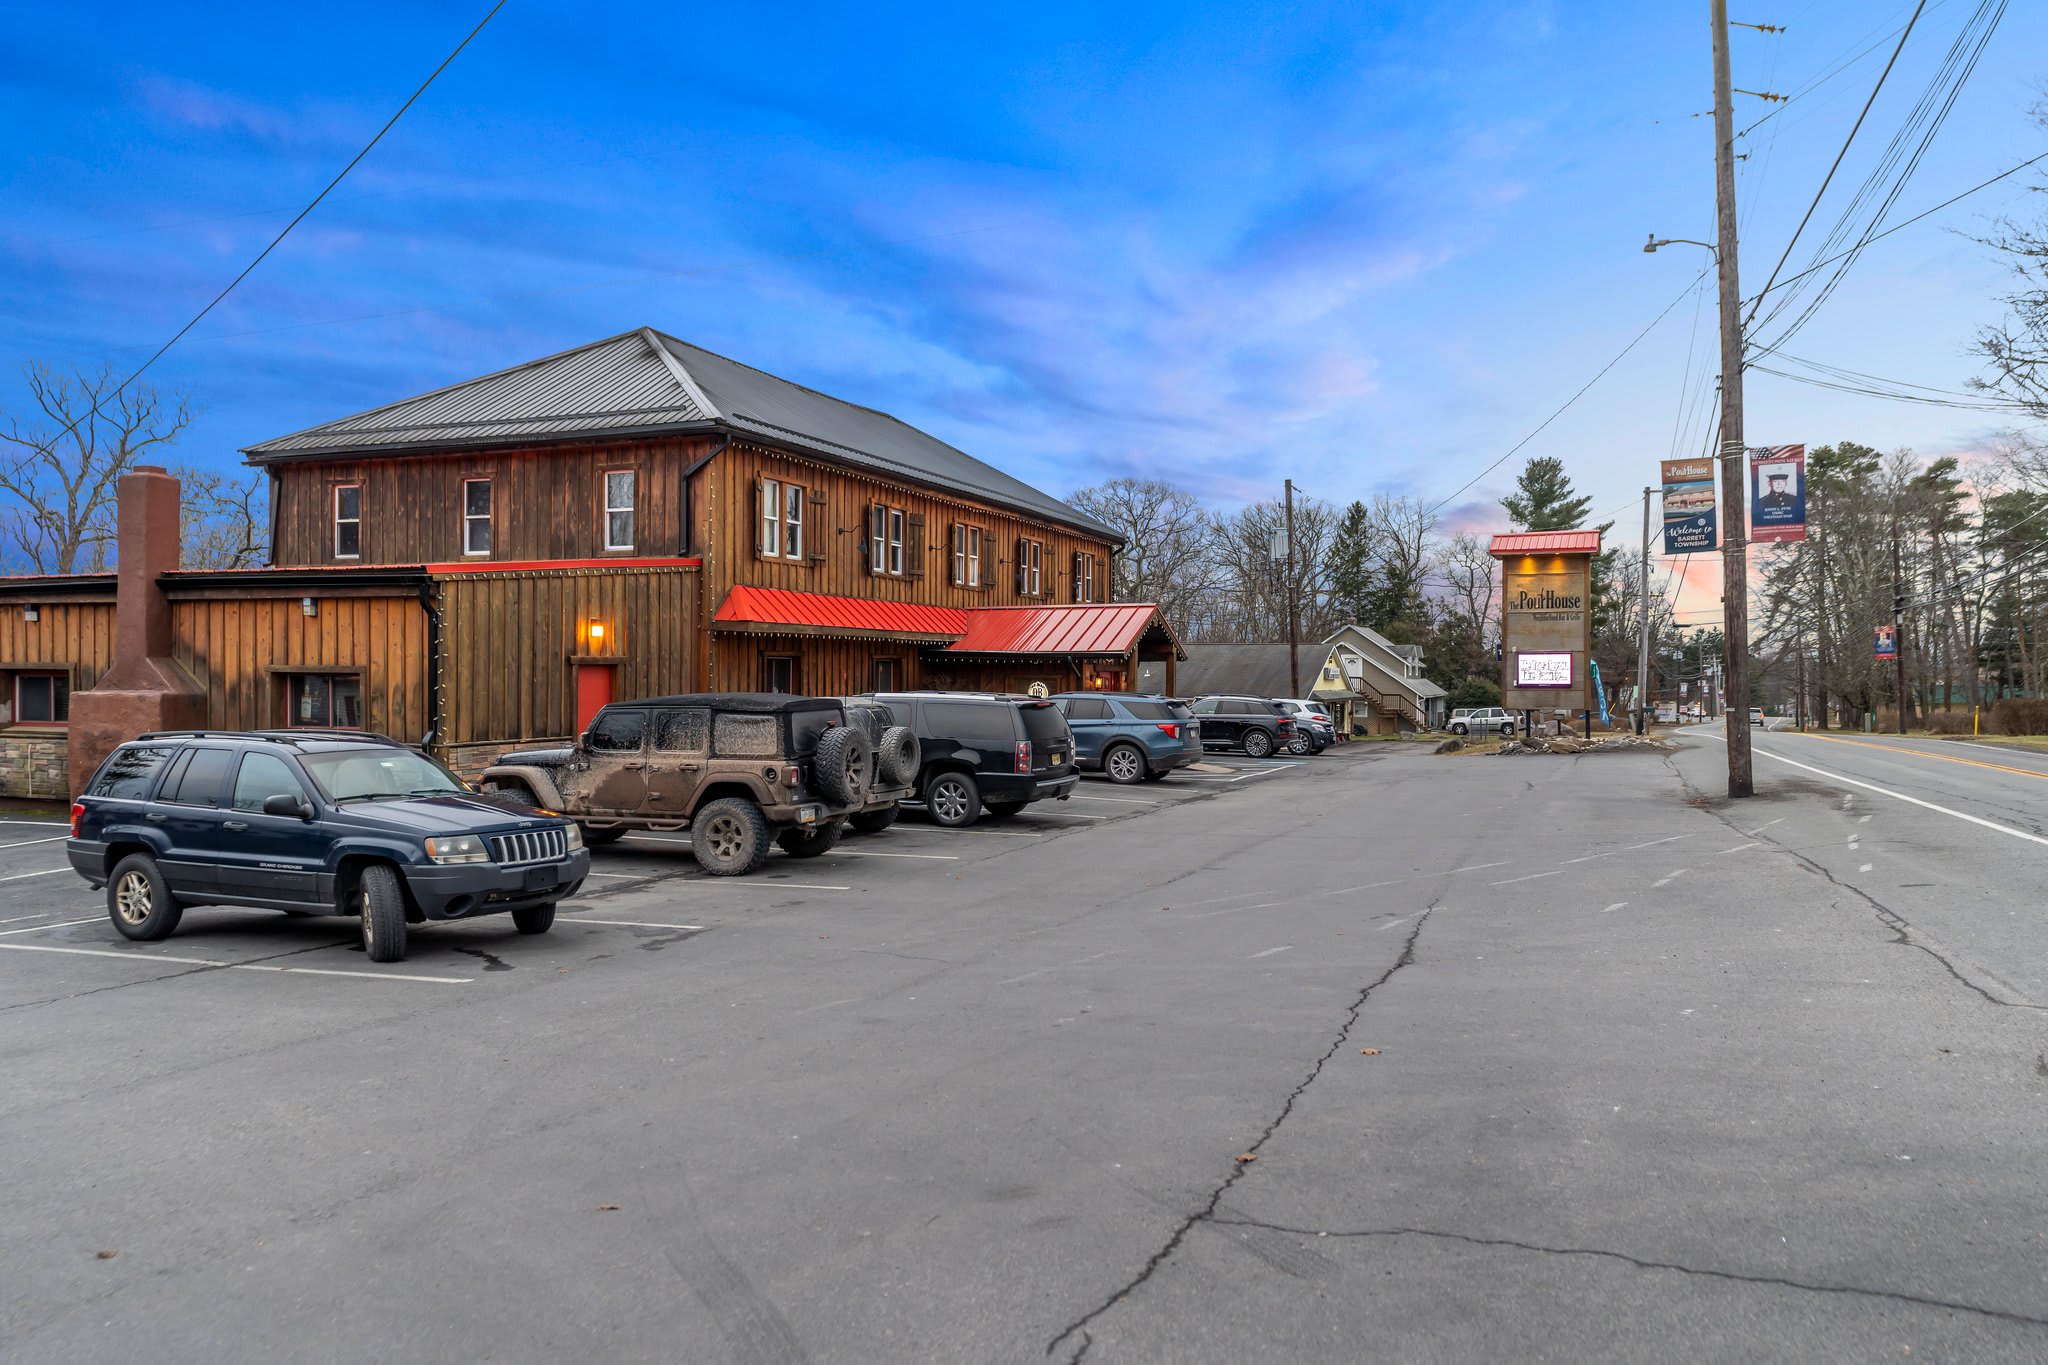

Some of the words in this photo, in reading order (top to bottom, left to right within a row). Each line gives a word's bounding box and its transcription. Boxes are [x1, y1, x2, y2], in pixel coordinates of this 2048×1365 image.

[1666, 525, 1703, 537] Welcome
[1677, 534, 1705, 542] BARRETT
[1674, 540, 1709, 548] TOWNSHIP
[1510, 601, 1519, 610] The
[1520, 589, 1580, 609] PourHouse
